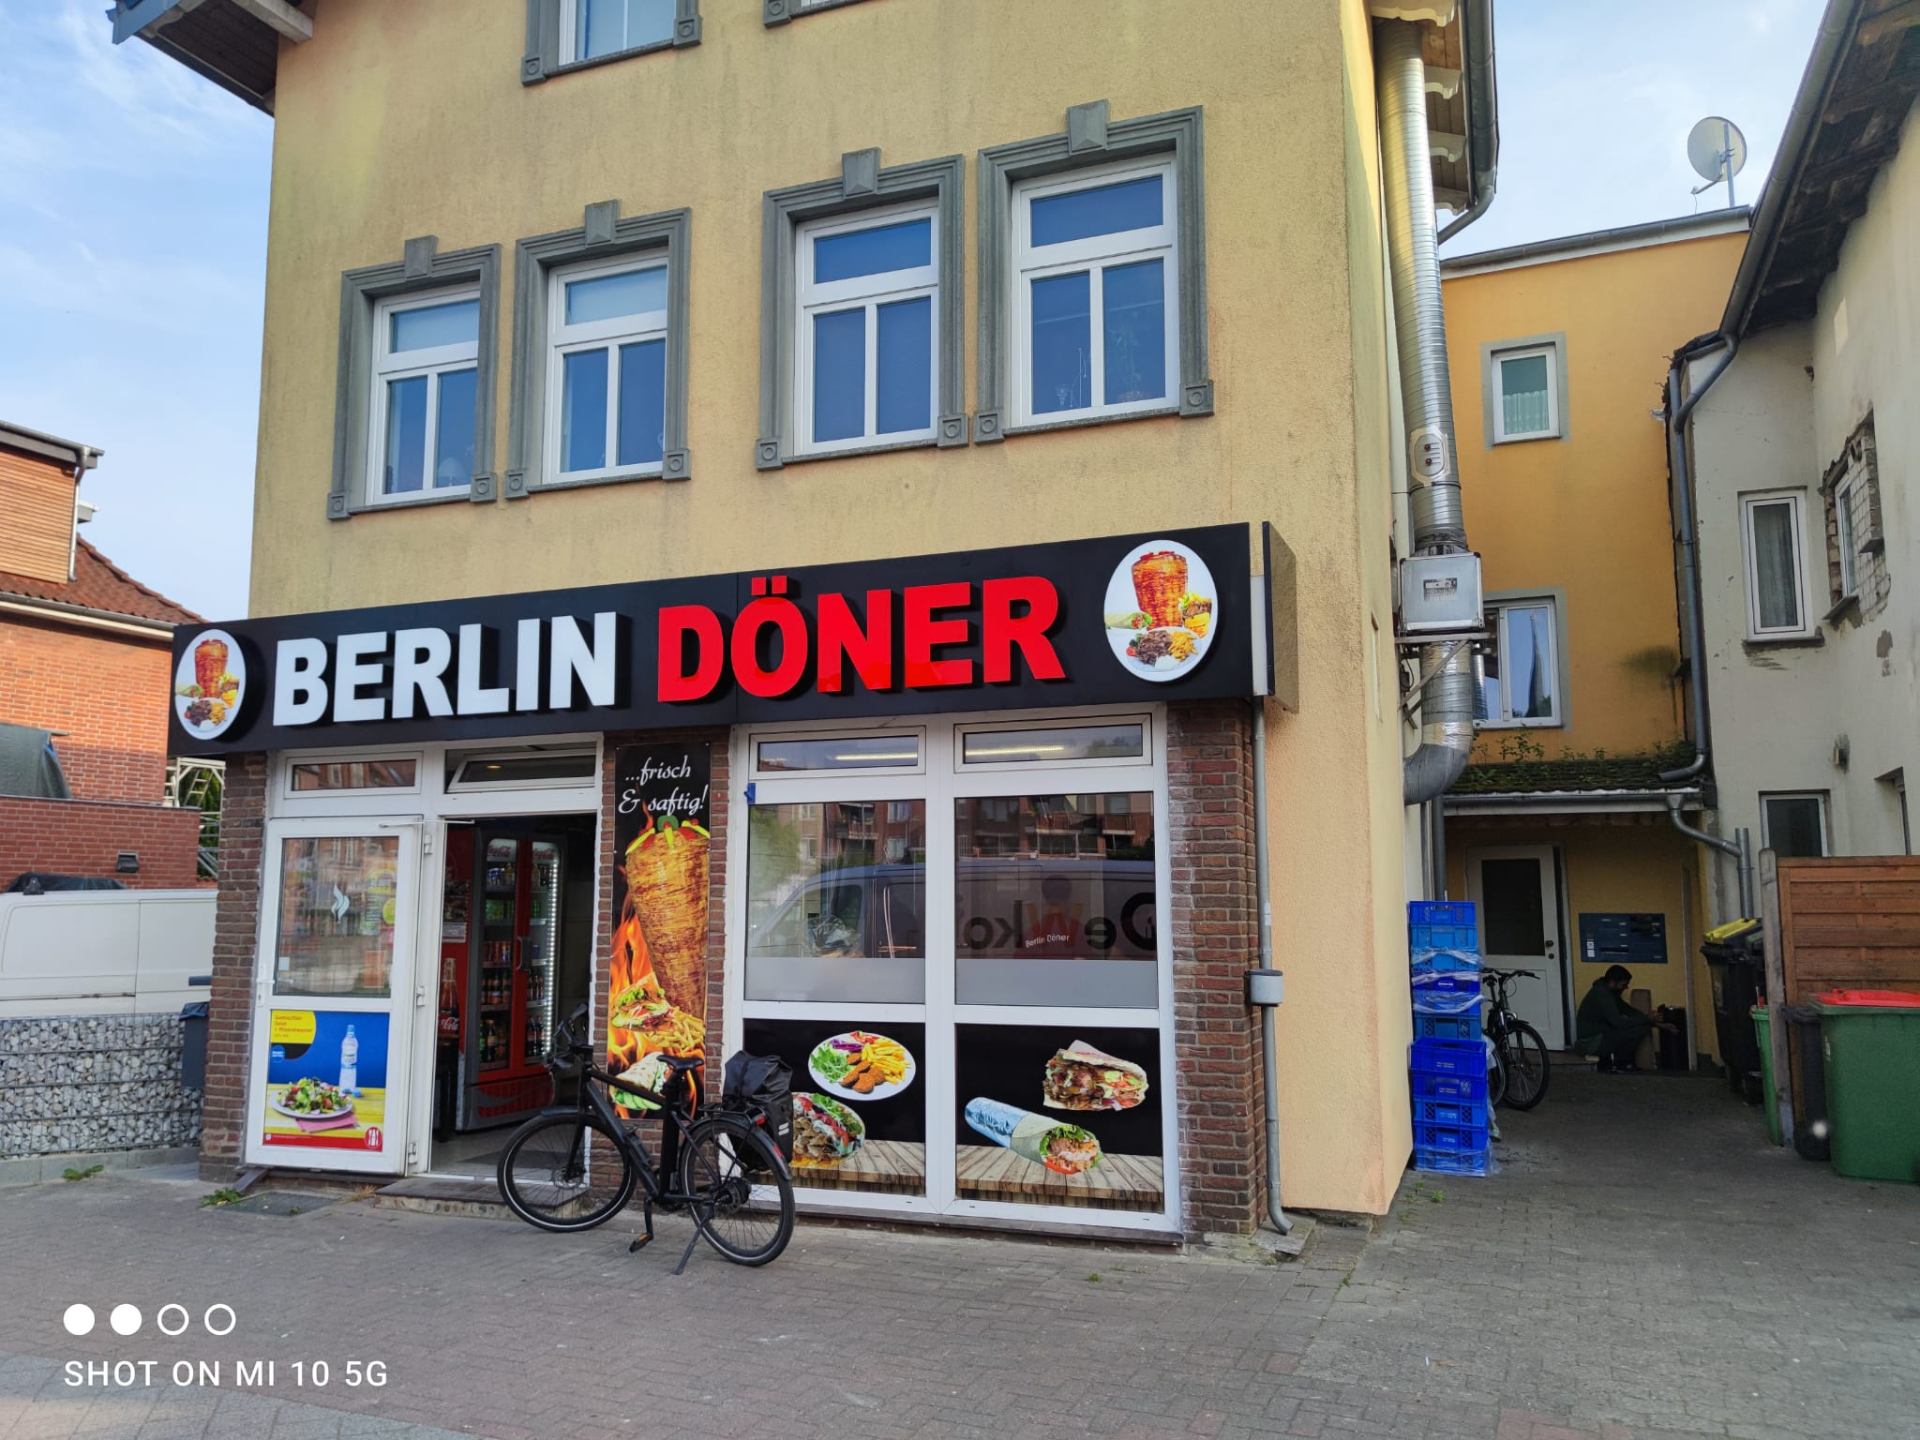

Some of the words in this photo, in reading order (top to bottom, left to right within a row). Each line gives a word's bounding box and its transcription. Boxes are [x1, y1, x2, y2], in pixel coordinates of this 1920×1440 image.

[273, 611, 616, 727] BERLIN
[657, 576, 1065, 702] DÖNER
[625, 755, 691, 786] ...frisch
[618, 788, 641, 814] &
[647, 784, 709, 817] saftig!
